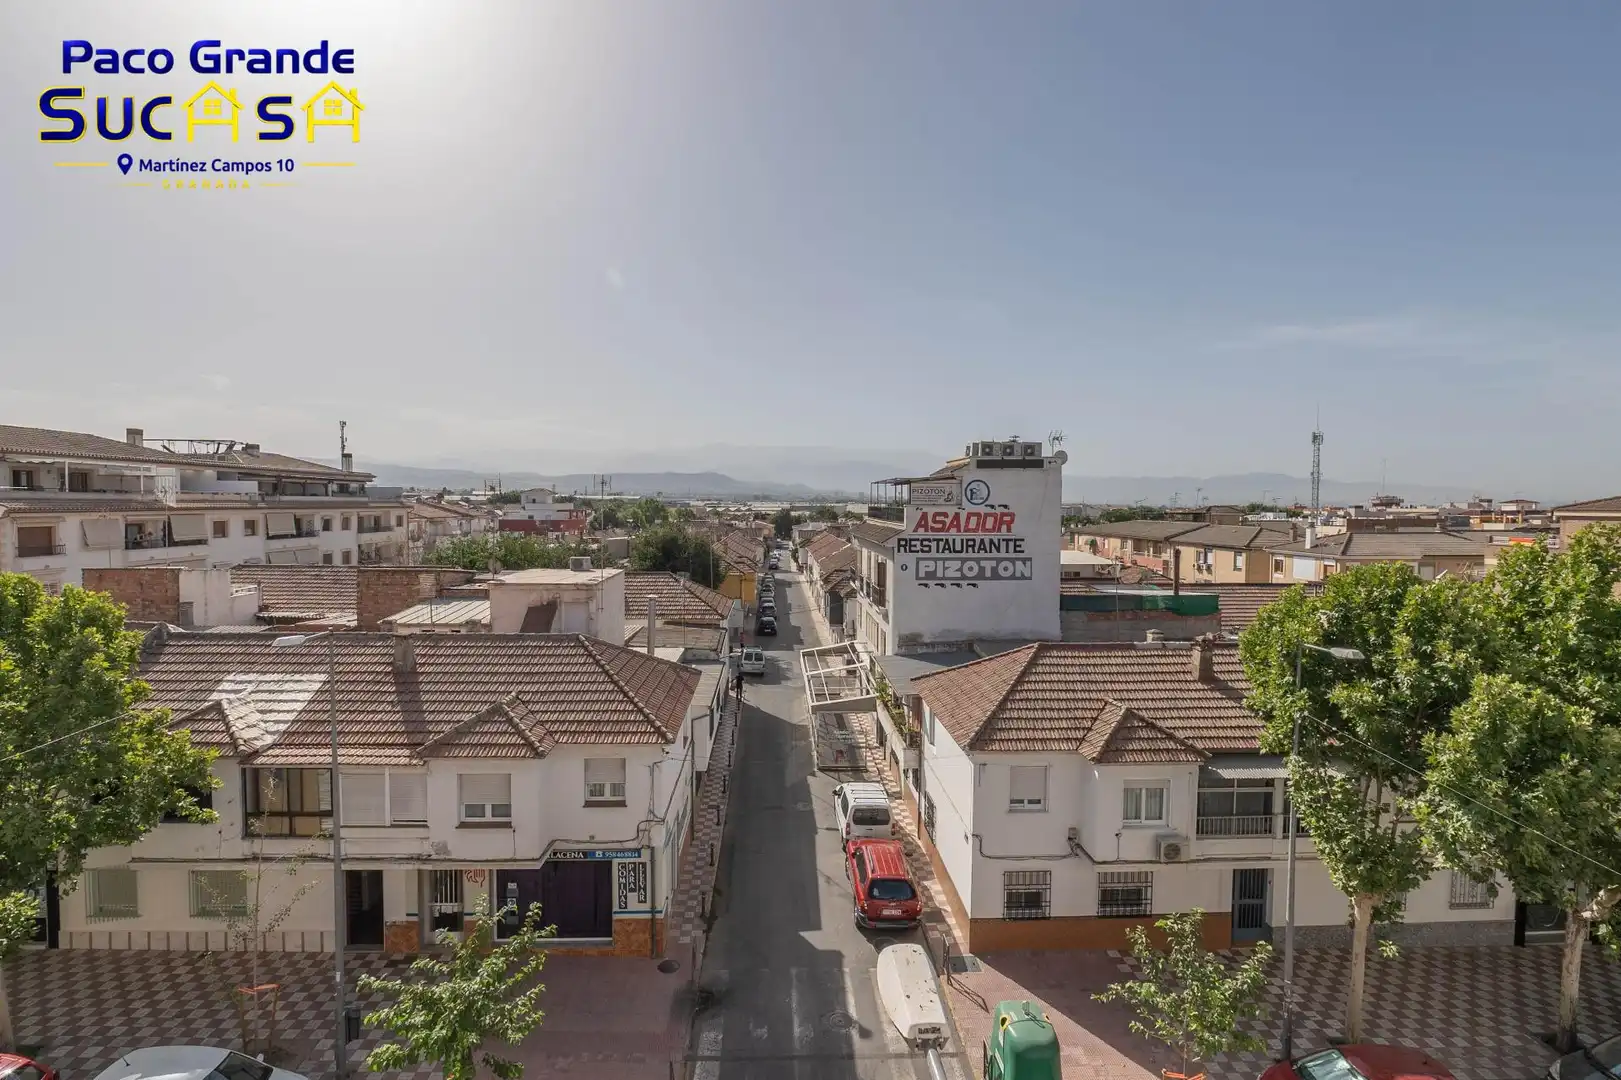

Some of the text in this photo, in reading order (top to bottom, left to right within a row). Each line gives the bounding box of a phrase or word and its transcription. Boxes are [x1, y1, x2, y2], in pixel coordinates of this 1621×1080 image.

[912, 511, 1017, 534] ASADOR
[896, 537, 1025, 554] RESTAURANTE
[918, 560, 1032, 578] PIZOTON
[618, 863, 627, 909] COMIDAS
[628, 863, 636, 889] PARA
